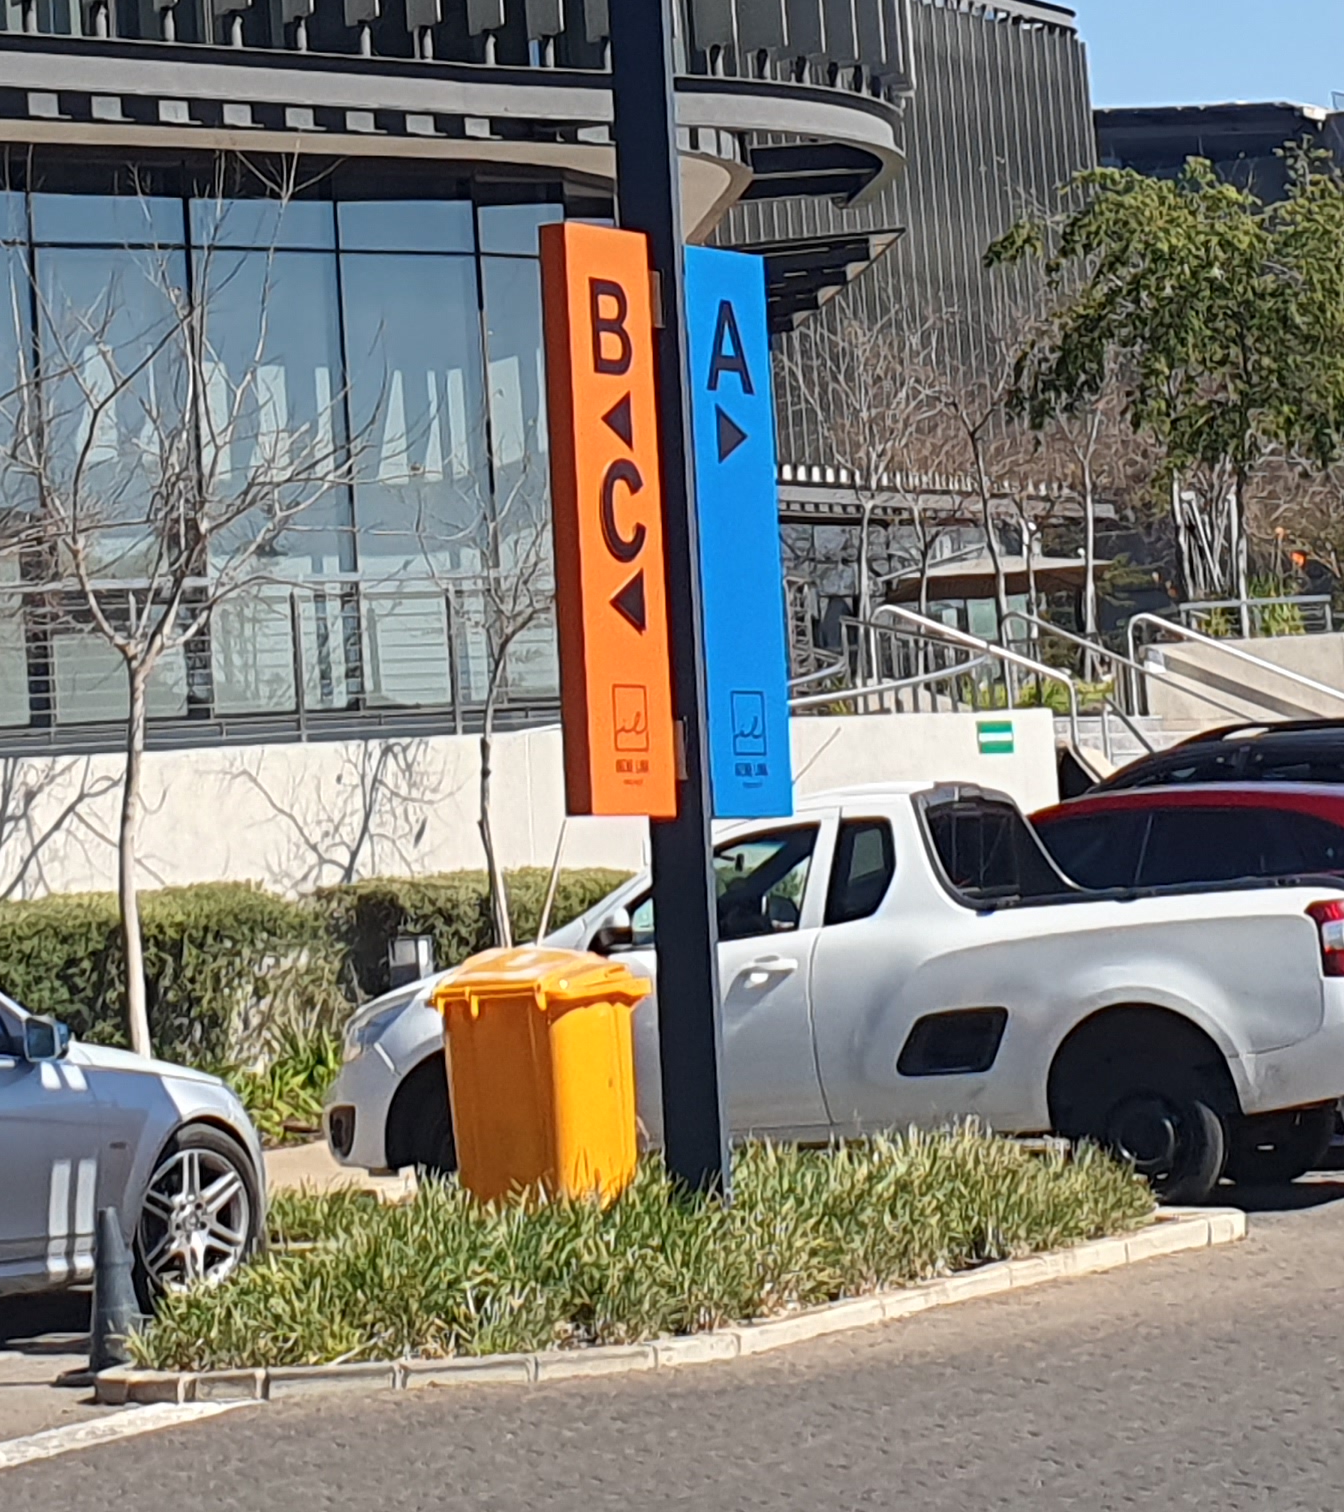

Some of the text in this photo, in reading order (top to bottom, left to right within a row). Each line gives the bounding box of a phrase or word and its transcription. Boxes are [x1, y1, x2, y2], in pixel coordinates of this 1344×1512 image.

[588, 276, 633, 376] B
[706, 298, 755, 396] A
[599, 457, 647, 564] C
